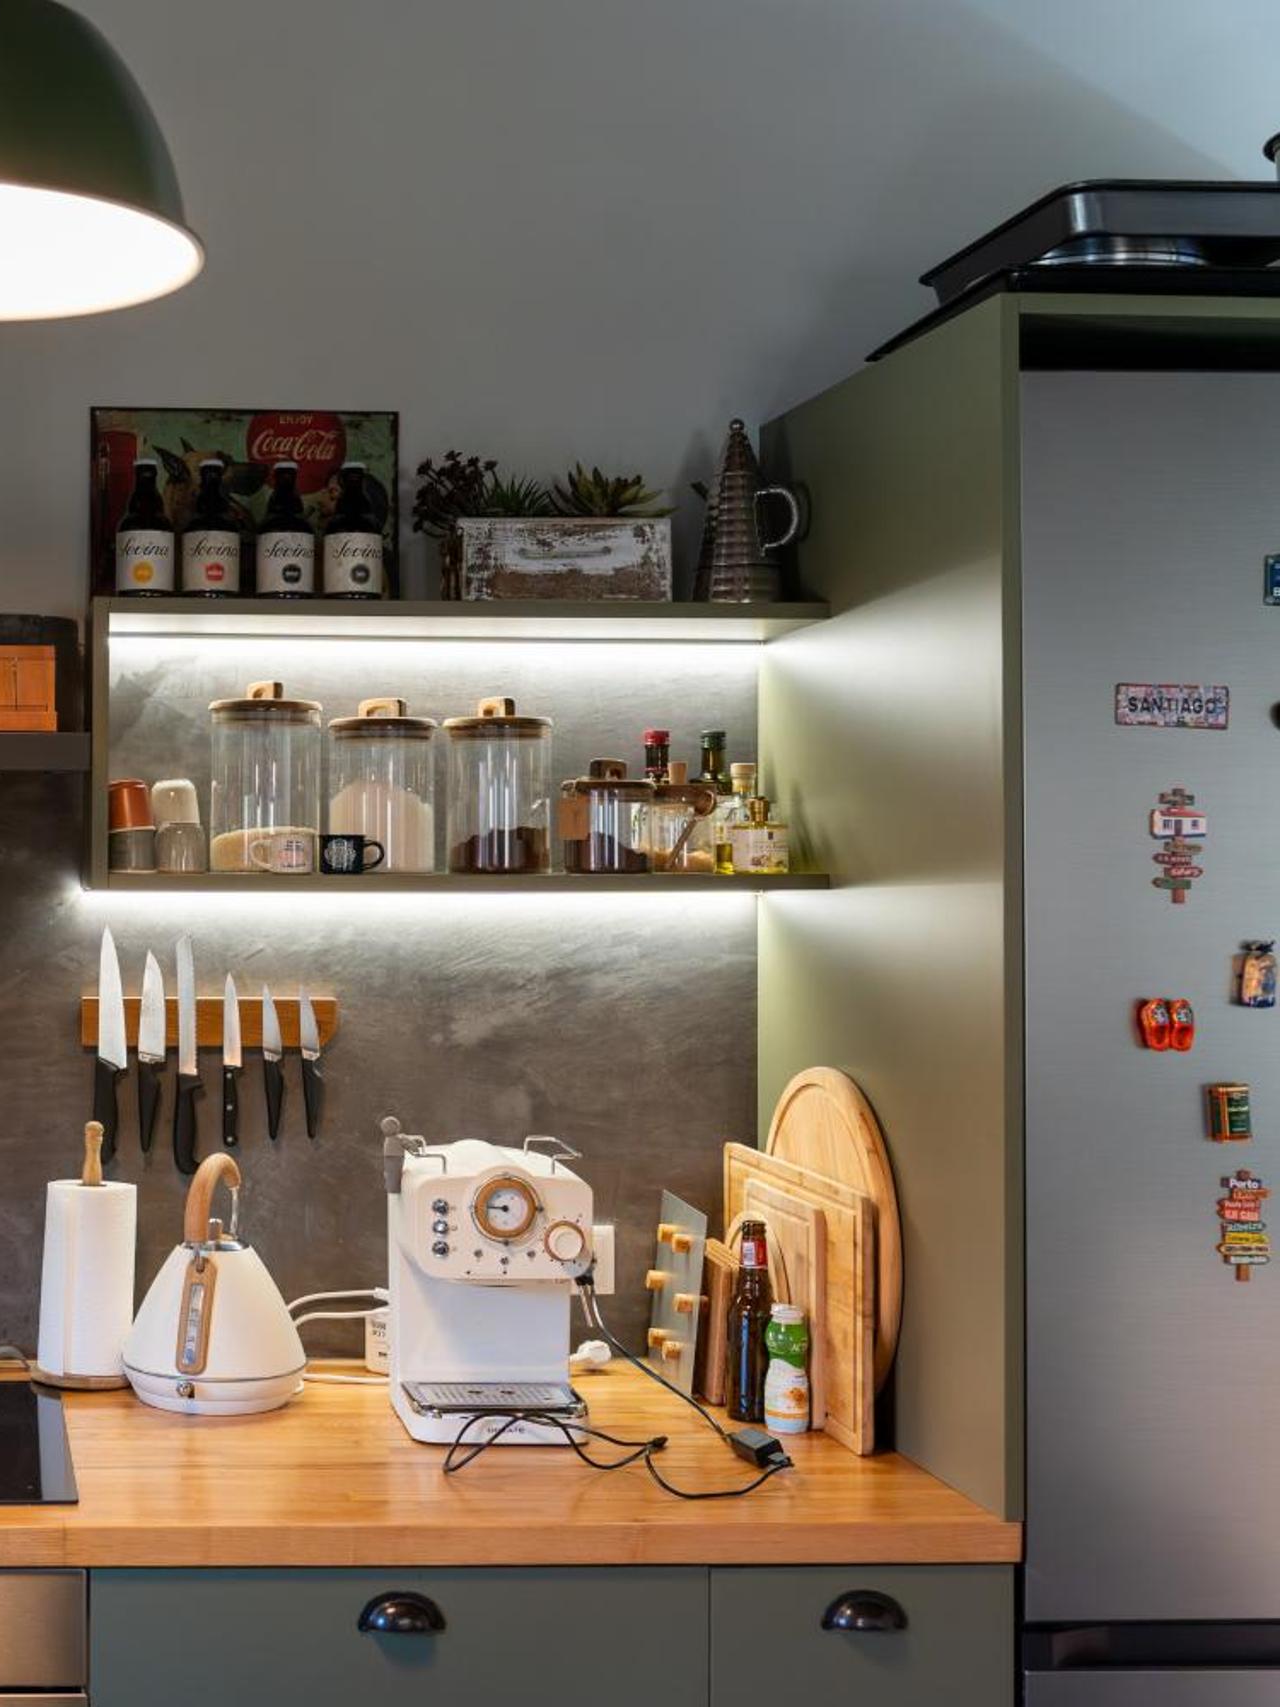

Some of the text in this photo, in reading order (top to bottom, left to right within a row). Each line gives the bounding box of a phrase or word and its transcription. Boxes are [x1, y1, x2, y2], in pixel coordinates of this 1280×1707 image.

[278, 414, 313, 425] ENJOY
[1127, 696, 1215, 715] SANTIAGO
[1229, 1179, 1259, 1189] Porto
